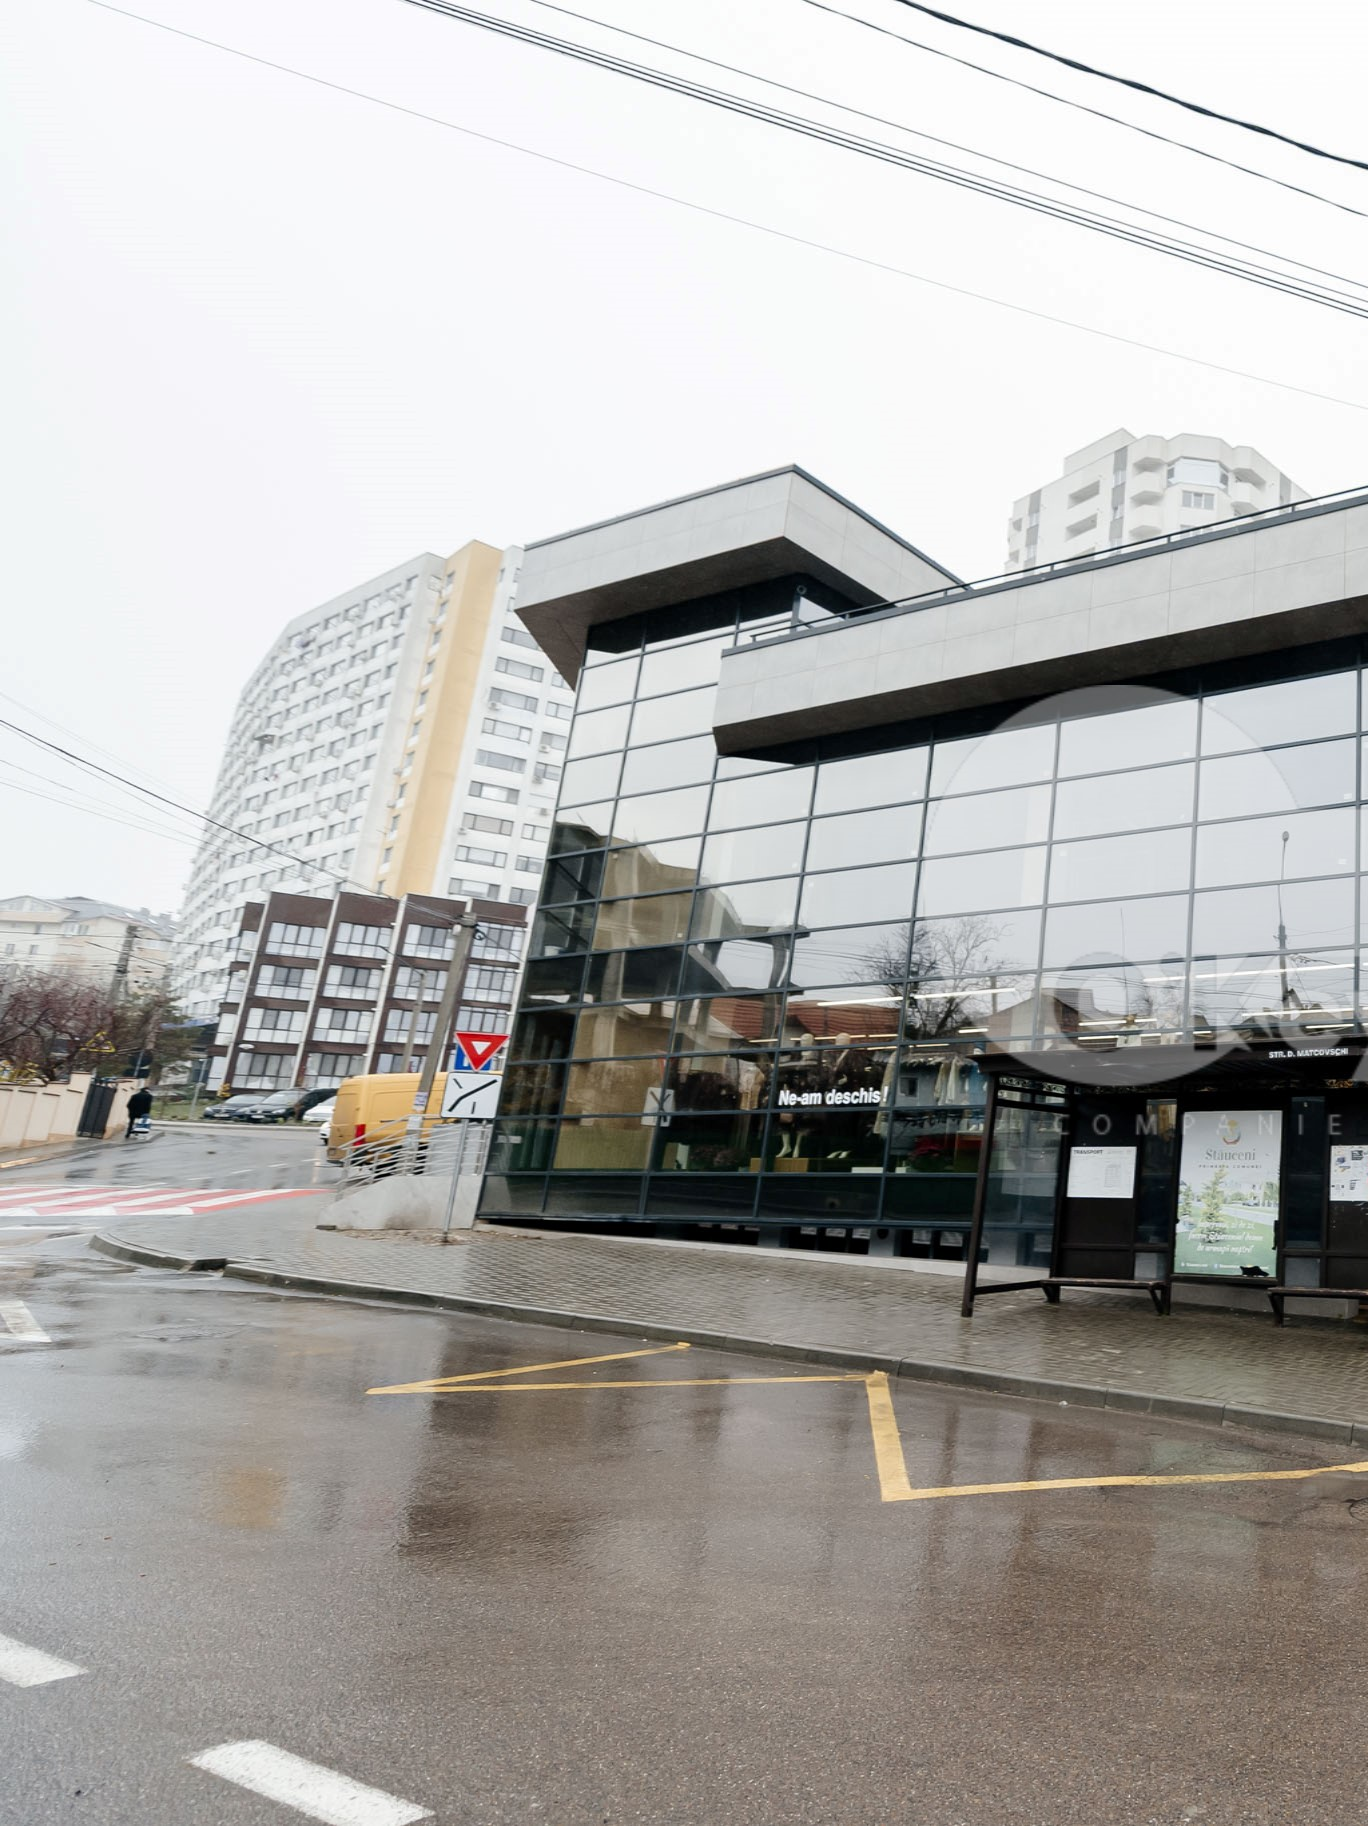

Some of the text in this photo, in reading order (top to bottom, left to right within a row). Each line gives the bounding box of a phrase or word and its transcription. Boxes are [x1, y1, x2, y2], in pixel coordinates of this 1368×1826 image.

[1269, 1050, 1286, 1058] STR.
[1297, 1048, 1348, 1057] MATCOVSCHI
[778, 1089, 822, 1106] Ne-am
